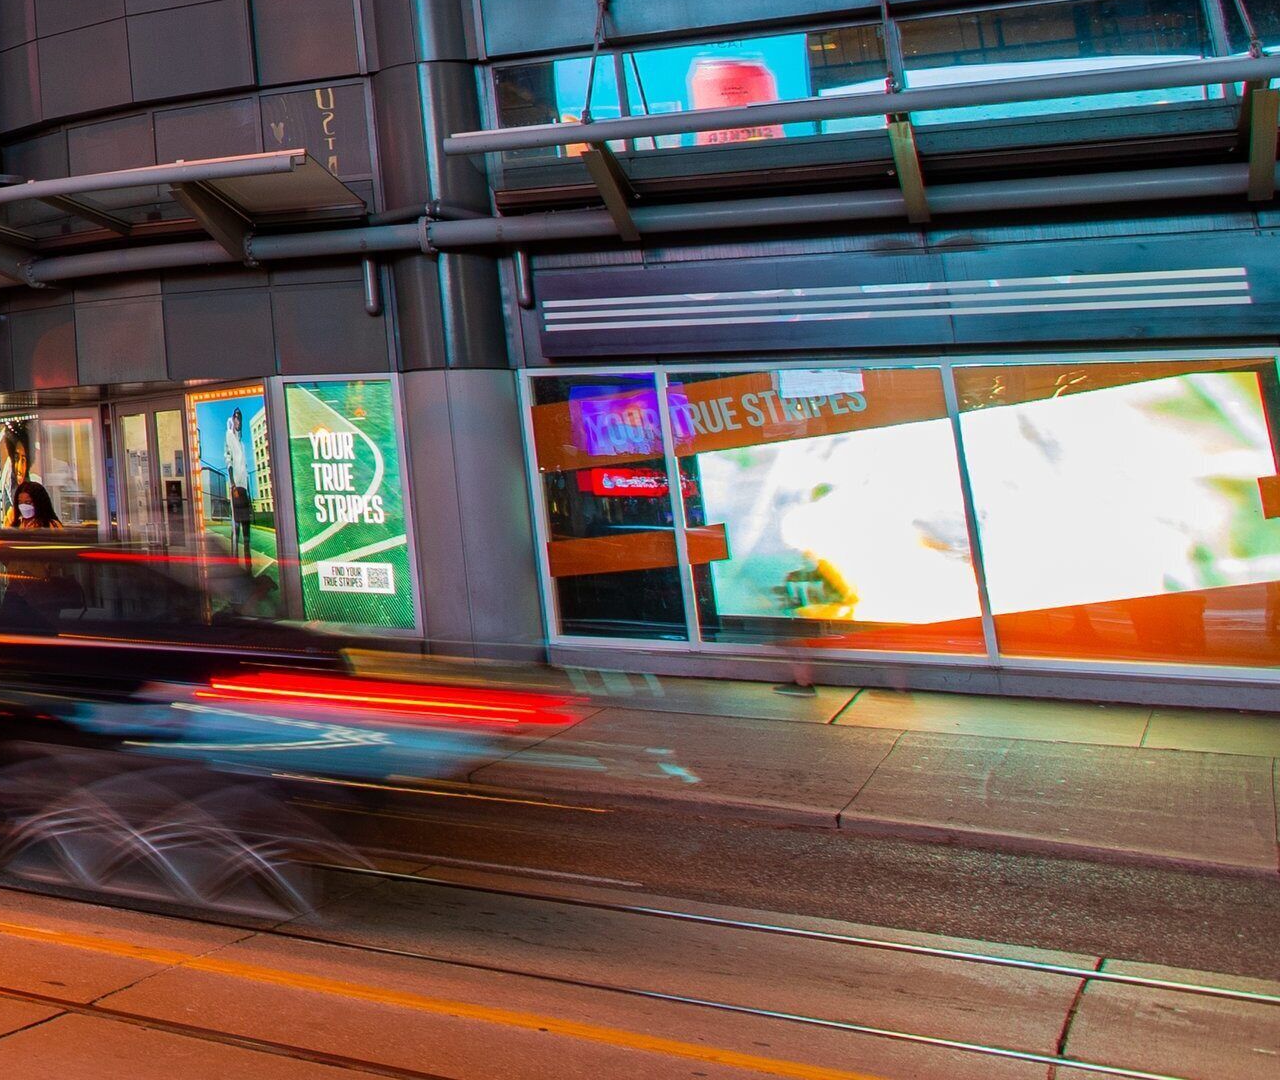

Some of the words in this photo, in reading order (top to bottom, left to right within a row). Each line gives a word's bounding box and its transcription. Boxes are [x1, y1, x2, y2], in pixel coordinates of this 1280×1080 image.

[741, 385, 868, 427] STRIPES
[308, 431, 356, 461] YOUR
[311, 463, 356, 492] TRUE
[314, 494, 385, 524] STRIPES
[322, 577, 338, 588] TRUE
[338, 577, 364, 589] STRIPES
[331, 566, 344, 577] FIND
[346, 566, 363, 578] YOUR
